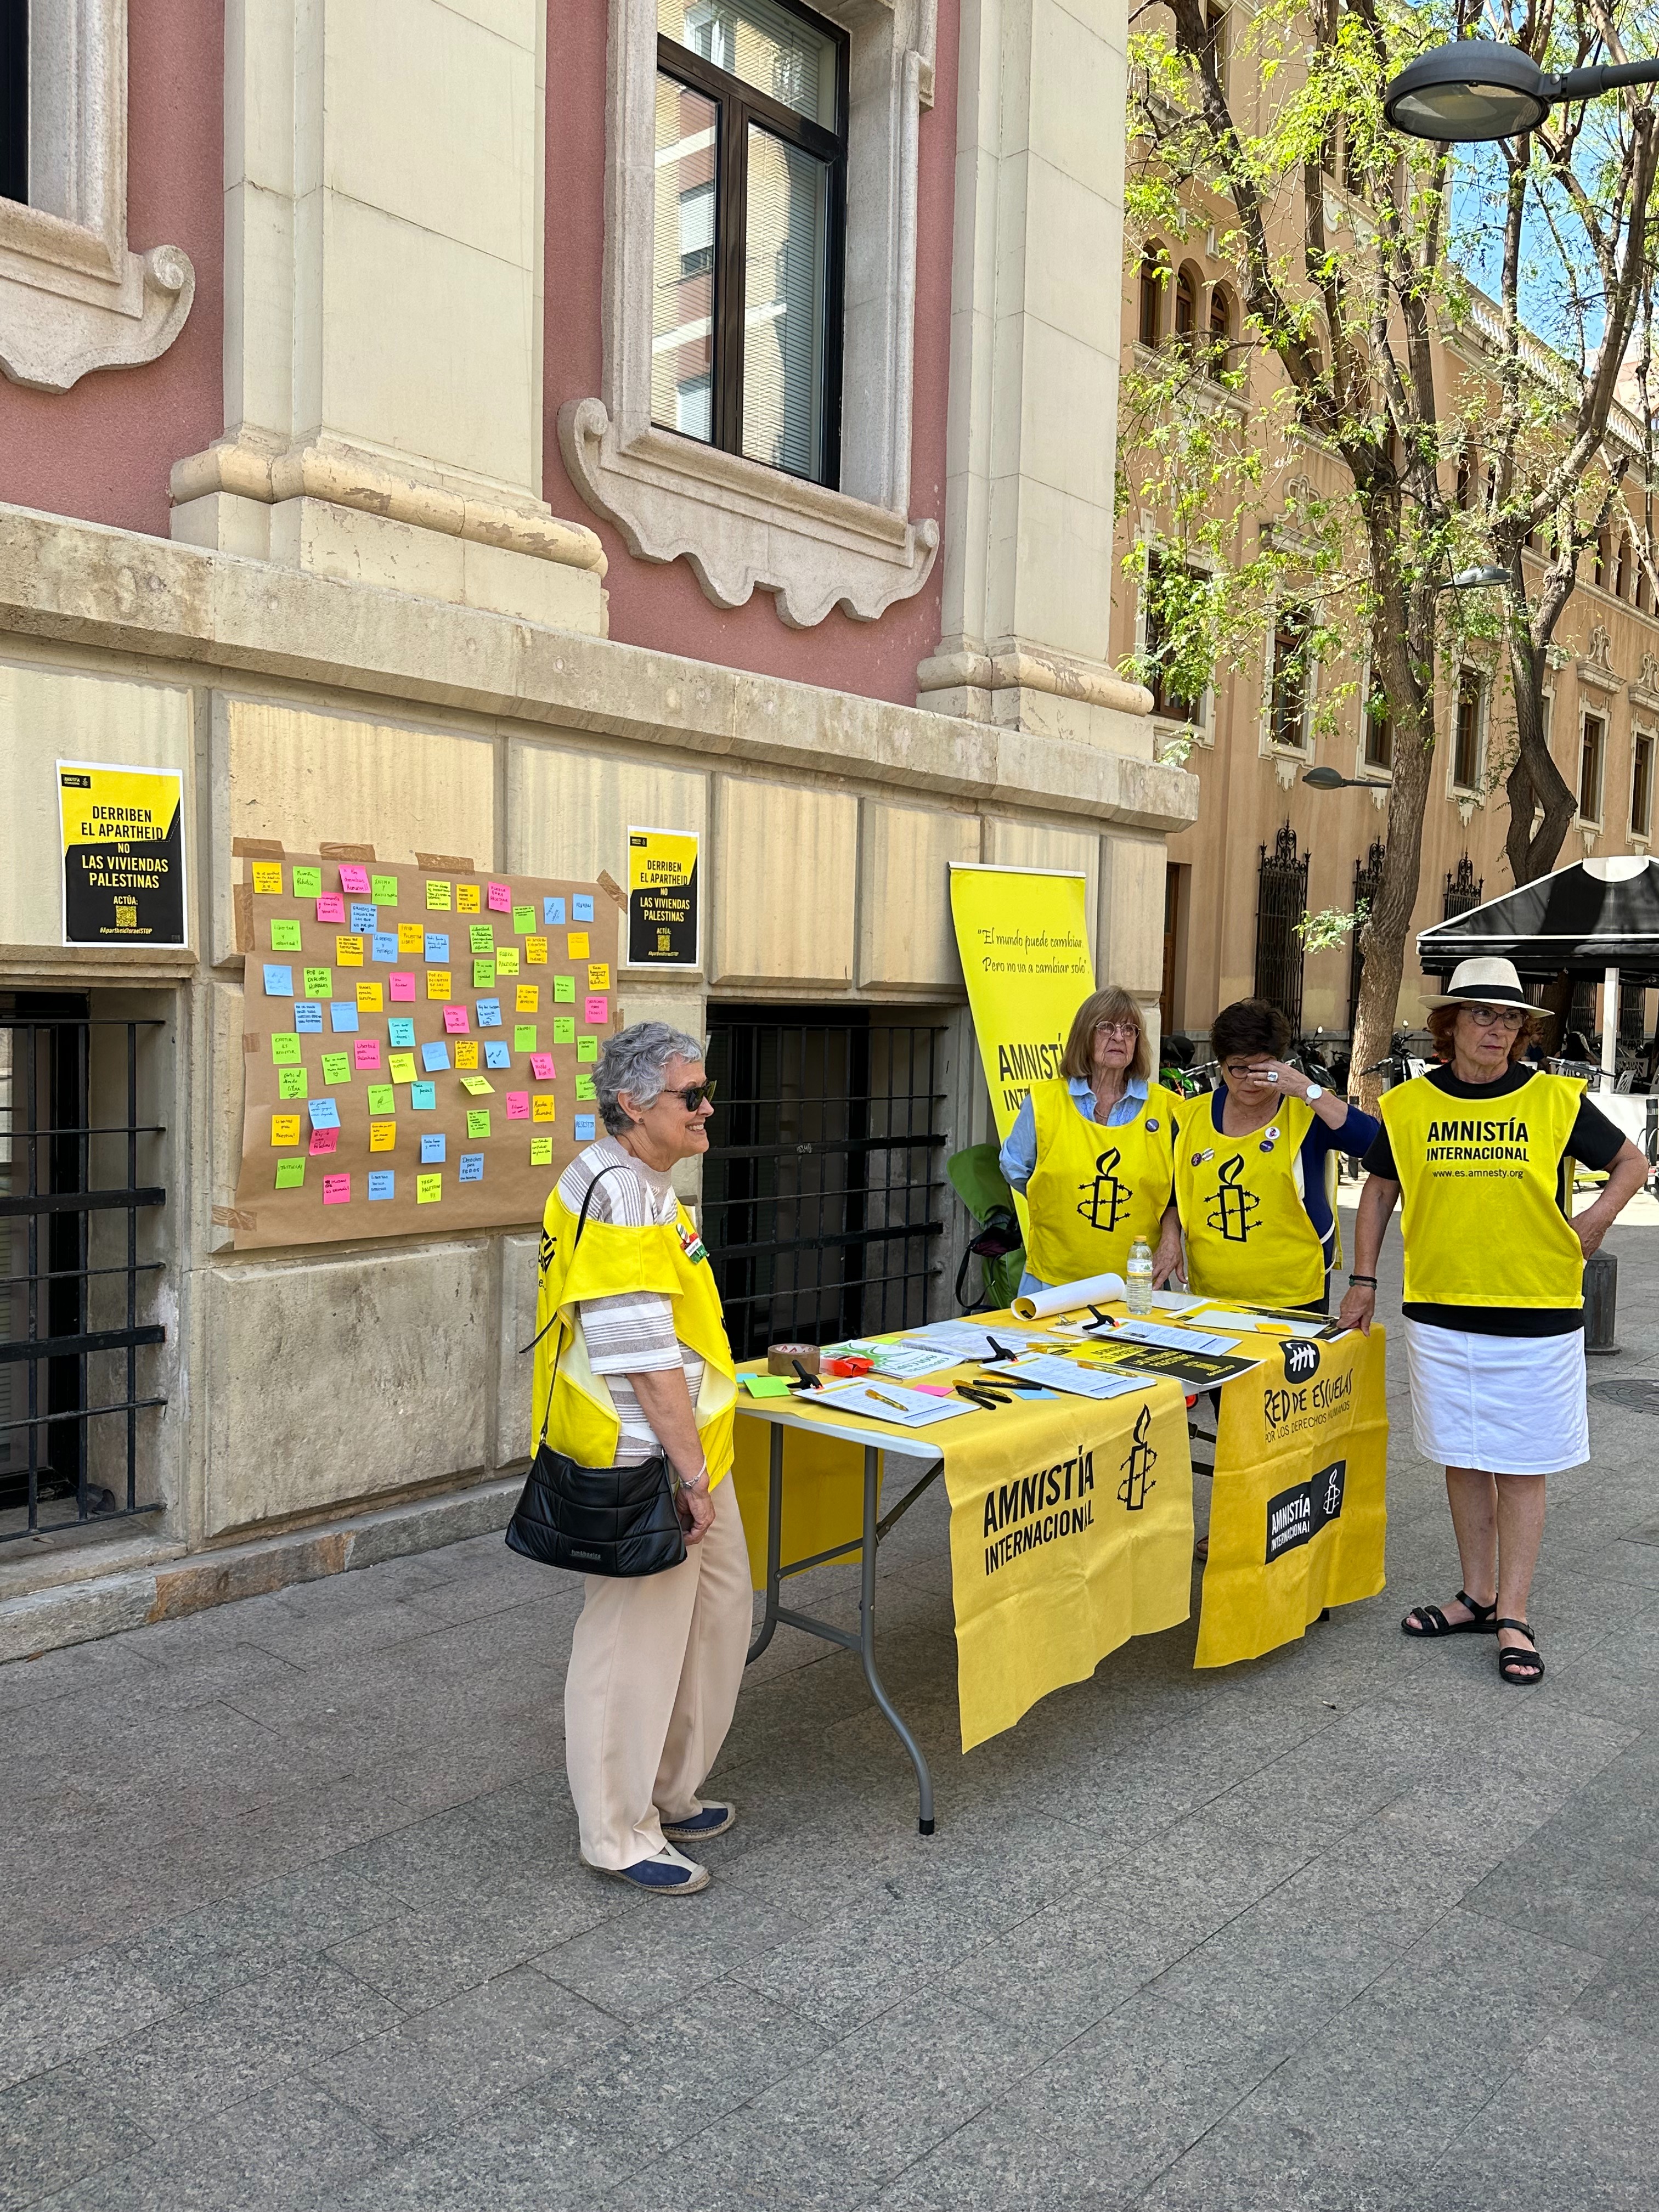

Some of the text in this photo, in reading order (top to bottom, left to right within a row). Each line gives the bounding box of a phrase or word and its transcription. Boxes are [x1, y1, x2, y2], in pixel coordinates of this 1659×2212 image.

[93, 806, 151, 822] DERRIBEN
[82, 823, 163, 840] EL APARTHEID
[118, 843, 129, 854] NO
[82, 855, 168, 872] LAS VIVIENDAS
[647, 860, 681, 872] DERRIBEN
[89, 873, 159, 889] PALESTINAS
[640, 872, 688, 885] EL APARTHEID
[113, 894, 138, 905] ACTÚA:
[660, 888, 668, 896] NO
[640, 897, 690, 910] LAS VIVIENDAS
[644, 910, 685, 922] PALESTINAS
[996, 929, 1023, 946] mundo
[1025, 930, 1048, 955] puede
[983, 957, 1005, 972] Pero
[1007, 961, 1016, 972] no
[1017, 963, 1026, 973] va
[1028, 963, 1033, 973] a
[1035, 956, 1069, 973] cambiar
[998, 1033, 1064, 1081] AMNISTÍ
[1427, 1117, 1529, 1142] AMNISTÍA
[1426, 1147, 1530, 1162] INTERNACIONAL
[1432, 1169, 1523, 1179] www.es.amnesty.org
[1264, 1368, 1353, 1431] RED DE ESCUELAS
[1265, 1401, 1350, 1444] POR LOS DERECHOS HUMANOS
[984, 1444, 1094, 1538] AMNISTÍA
[1272, 1493, 1311, 1536] AMNISTÍA
